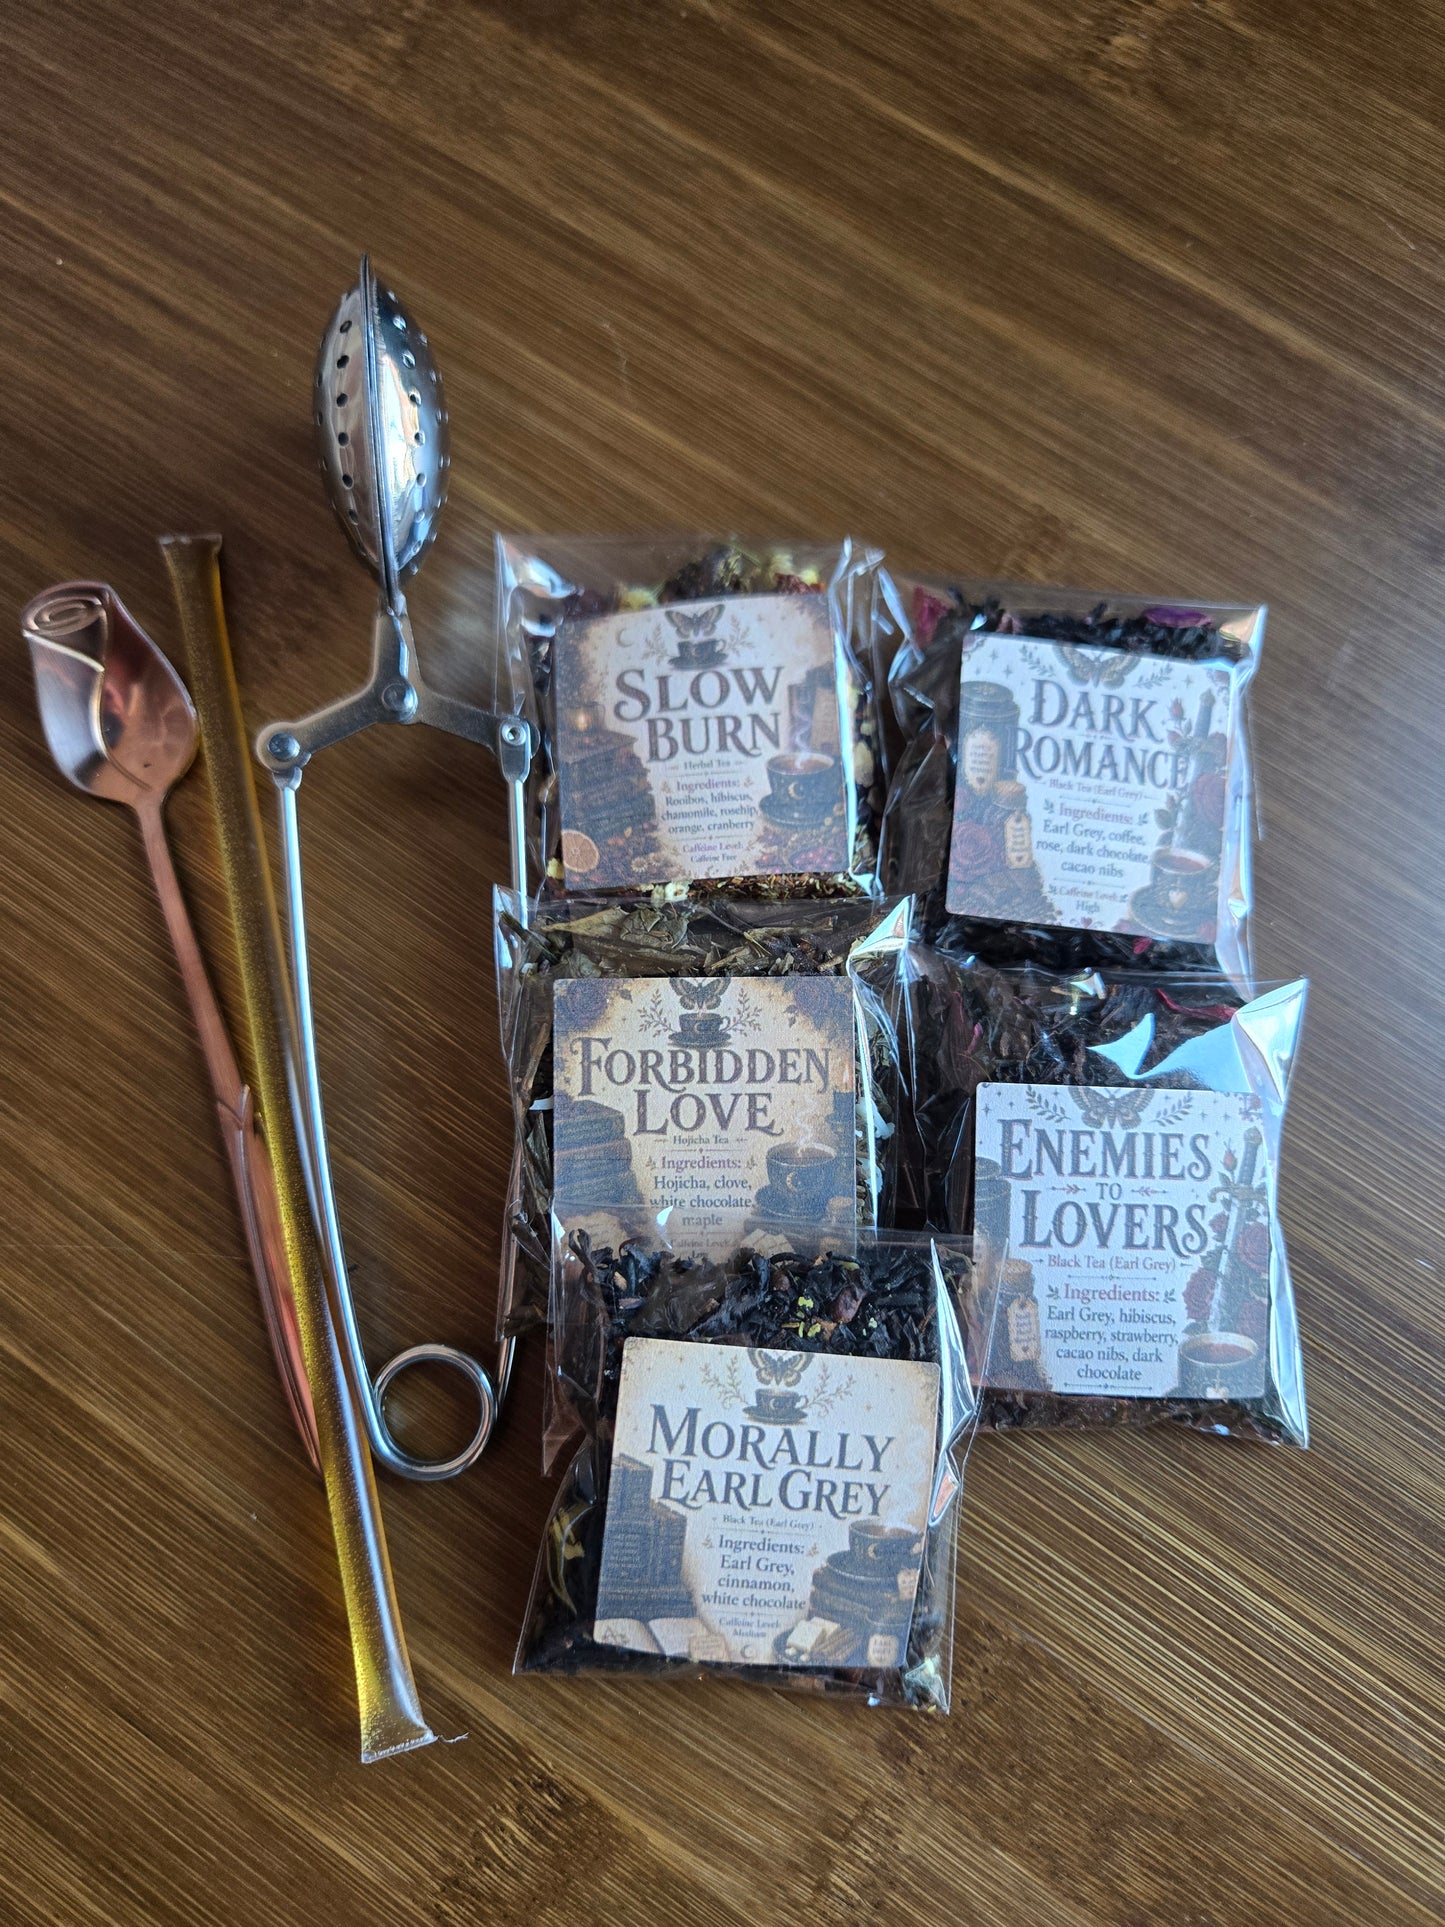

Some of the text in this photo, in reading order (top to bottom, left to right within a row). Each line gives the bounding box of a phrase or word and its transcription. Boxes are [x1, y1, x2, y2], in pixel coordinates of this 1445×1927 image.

[613, 666, 784, 722] SLOW
[1029, 678, 1164, 743] DARK
[646, 712, 781, 763] BURN
[684, 759, 731, 770] Herbal Tea
[1014, 726, 1189, 790] ROMANCE
[676, 778, 740, 793] Ingredients:
[1049, 778, 1143, 801] Black Tea (Earl Grey)
[665, 792, 753, 806] Rooibos, hibiscus,
[661, 804, 758, 821] chamomile, rosehip,
[1059, 803, 1133, 825] Ingredients:
[668, 819, 754, 834] orange, cranberry
[1043, 819, 1146, 846] Earl Grey, coffee,
[683, 843, 717, 853] Caffeine
[1036, 839, 1063, 854] rose,
[1067, 841, 1094, 856] dark
[690, 853, 737, 863] Caffeine Free
[1060, 861, 1124, 878] cacao nibs
[1059, 886, 1093, 898] Caffeine
[1076, 900, 1100, 914] High
[570, 1037, 832, 1097] FORBIDDEN
[633, 1089, 784, 1137] LOVE
[673, 1134, 729, 1146] Hojicha Tea
[997, 1118, 1212, 1182] ENEMIES
[661, 1155, 742, 1173] Ingredients:
[654, 1175, 752, 1192] Hojicha, clove,
[1096, 1182, 1122, 1200] TO
[650, 1195, 686, 1208] white
[682, 1214, 723, 1229] maple
[1019, 1189, 1209, 1259] LOVERS
[1048, 1253, 1176, 1274] Black Tea (Earl Grey)
[1063, 1283, 1160, 1304] Ingredients:
[1047, 1305, 1176, 1326] Earl Grey, hibiscus,
[1045, 1325, 1107, 1345] raspberry,
[1110, 1328, 1179, 1347] strawberry,
[1056, 1346, 1163, 1362] cacao nibs, dark
[1077, 1364, 1142, 1380] chocolate
[646, 1403, 895, 1473] MORALLY
[658, 1458, 892, 1521] EARL GREY
[723, 1514, 814, 1531] Black Tea (Earl Grey)
[718, 1534, 805, 1554] Ingredients:
[720, 1554, 795, 1577] Earl Grey,
[718, 1574, 795, 1593] cinnamon,
[702, 1591, 806, 1610] white chocolate
[719, 1616, 754, 1627] Caffeine
